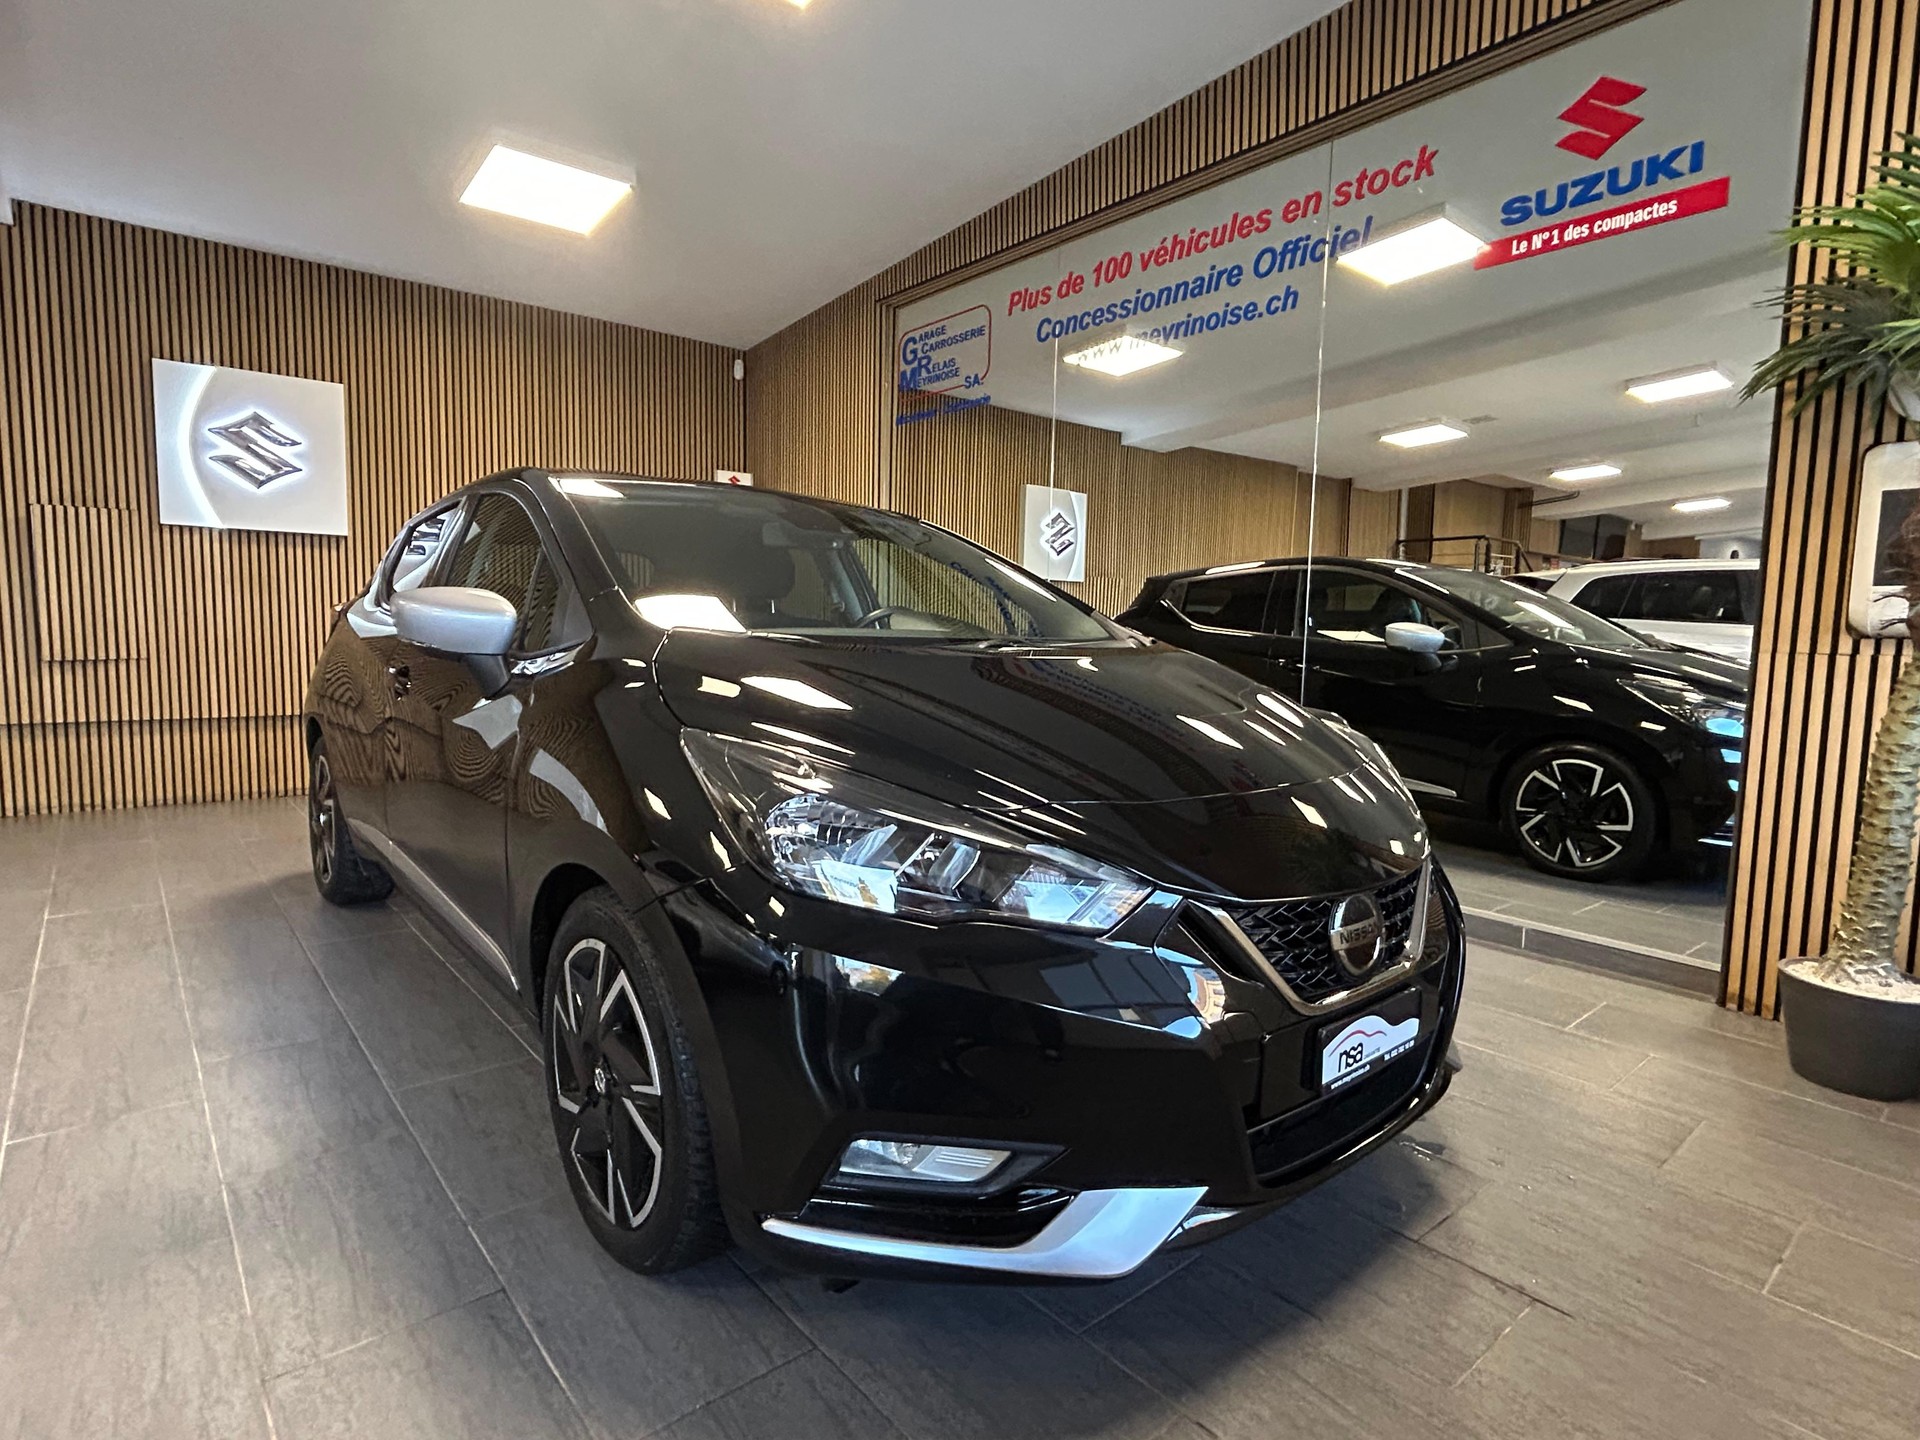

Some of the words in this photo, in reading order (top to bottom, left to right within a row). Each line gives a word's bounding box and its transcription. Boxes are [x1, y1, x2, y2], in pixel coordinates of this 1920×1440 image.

[1500, 140, 1705, 227] SUZUKI
[1007, 284, 1052, 317] Plus
[1057, 271, 1085, 299] de
[1093, 251, 1133, 288] 100
[1140, 209, 1273, 272] véhicules
[1282, 190, 1323, 224] en
[1332, 144, 1439, 208] stock
[1511, 238, 1528, 256] Le
[1531, 229, 1560, 251] N°1
[1564, 223, 1589, 242] des
[1593, 199, 1678, 235] compactes
[1036, 264, 1244, 344] Concessionnaire
[1253, 215, 1374, 279] Officiel
[920, 324, 987, 355] CARROSSERIE
[1337, 1042, 1364, 1073] nsa
